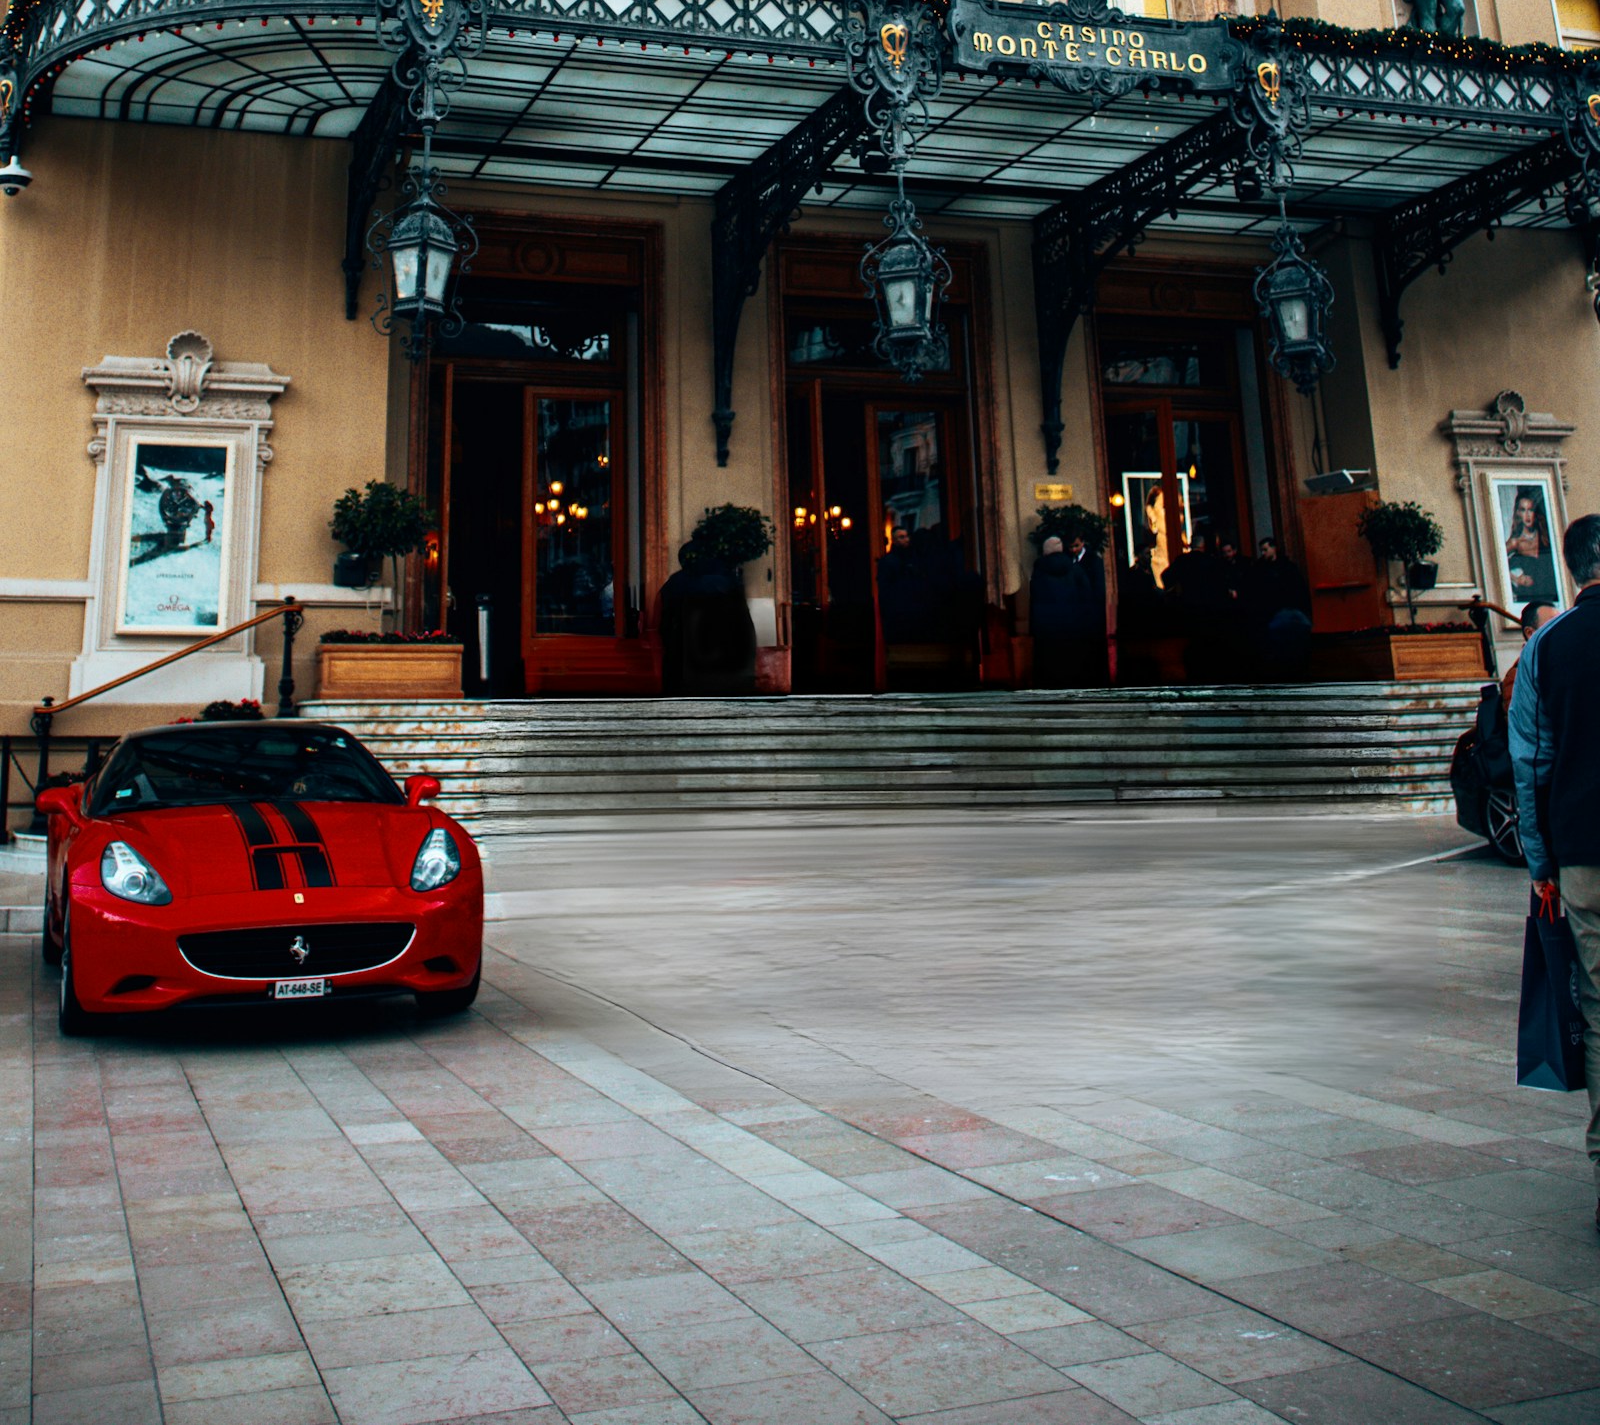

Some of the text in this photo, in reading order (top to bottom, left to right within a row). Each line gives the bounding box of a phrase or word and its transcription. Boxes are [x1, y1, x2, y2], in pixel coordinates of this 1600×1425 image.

[1037, 21, 1145, 48] CASINO
[157, 604, 190, 612] OMEGA
[277, 981, 322, 995] AT-648-SE
